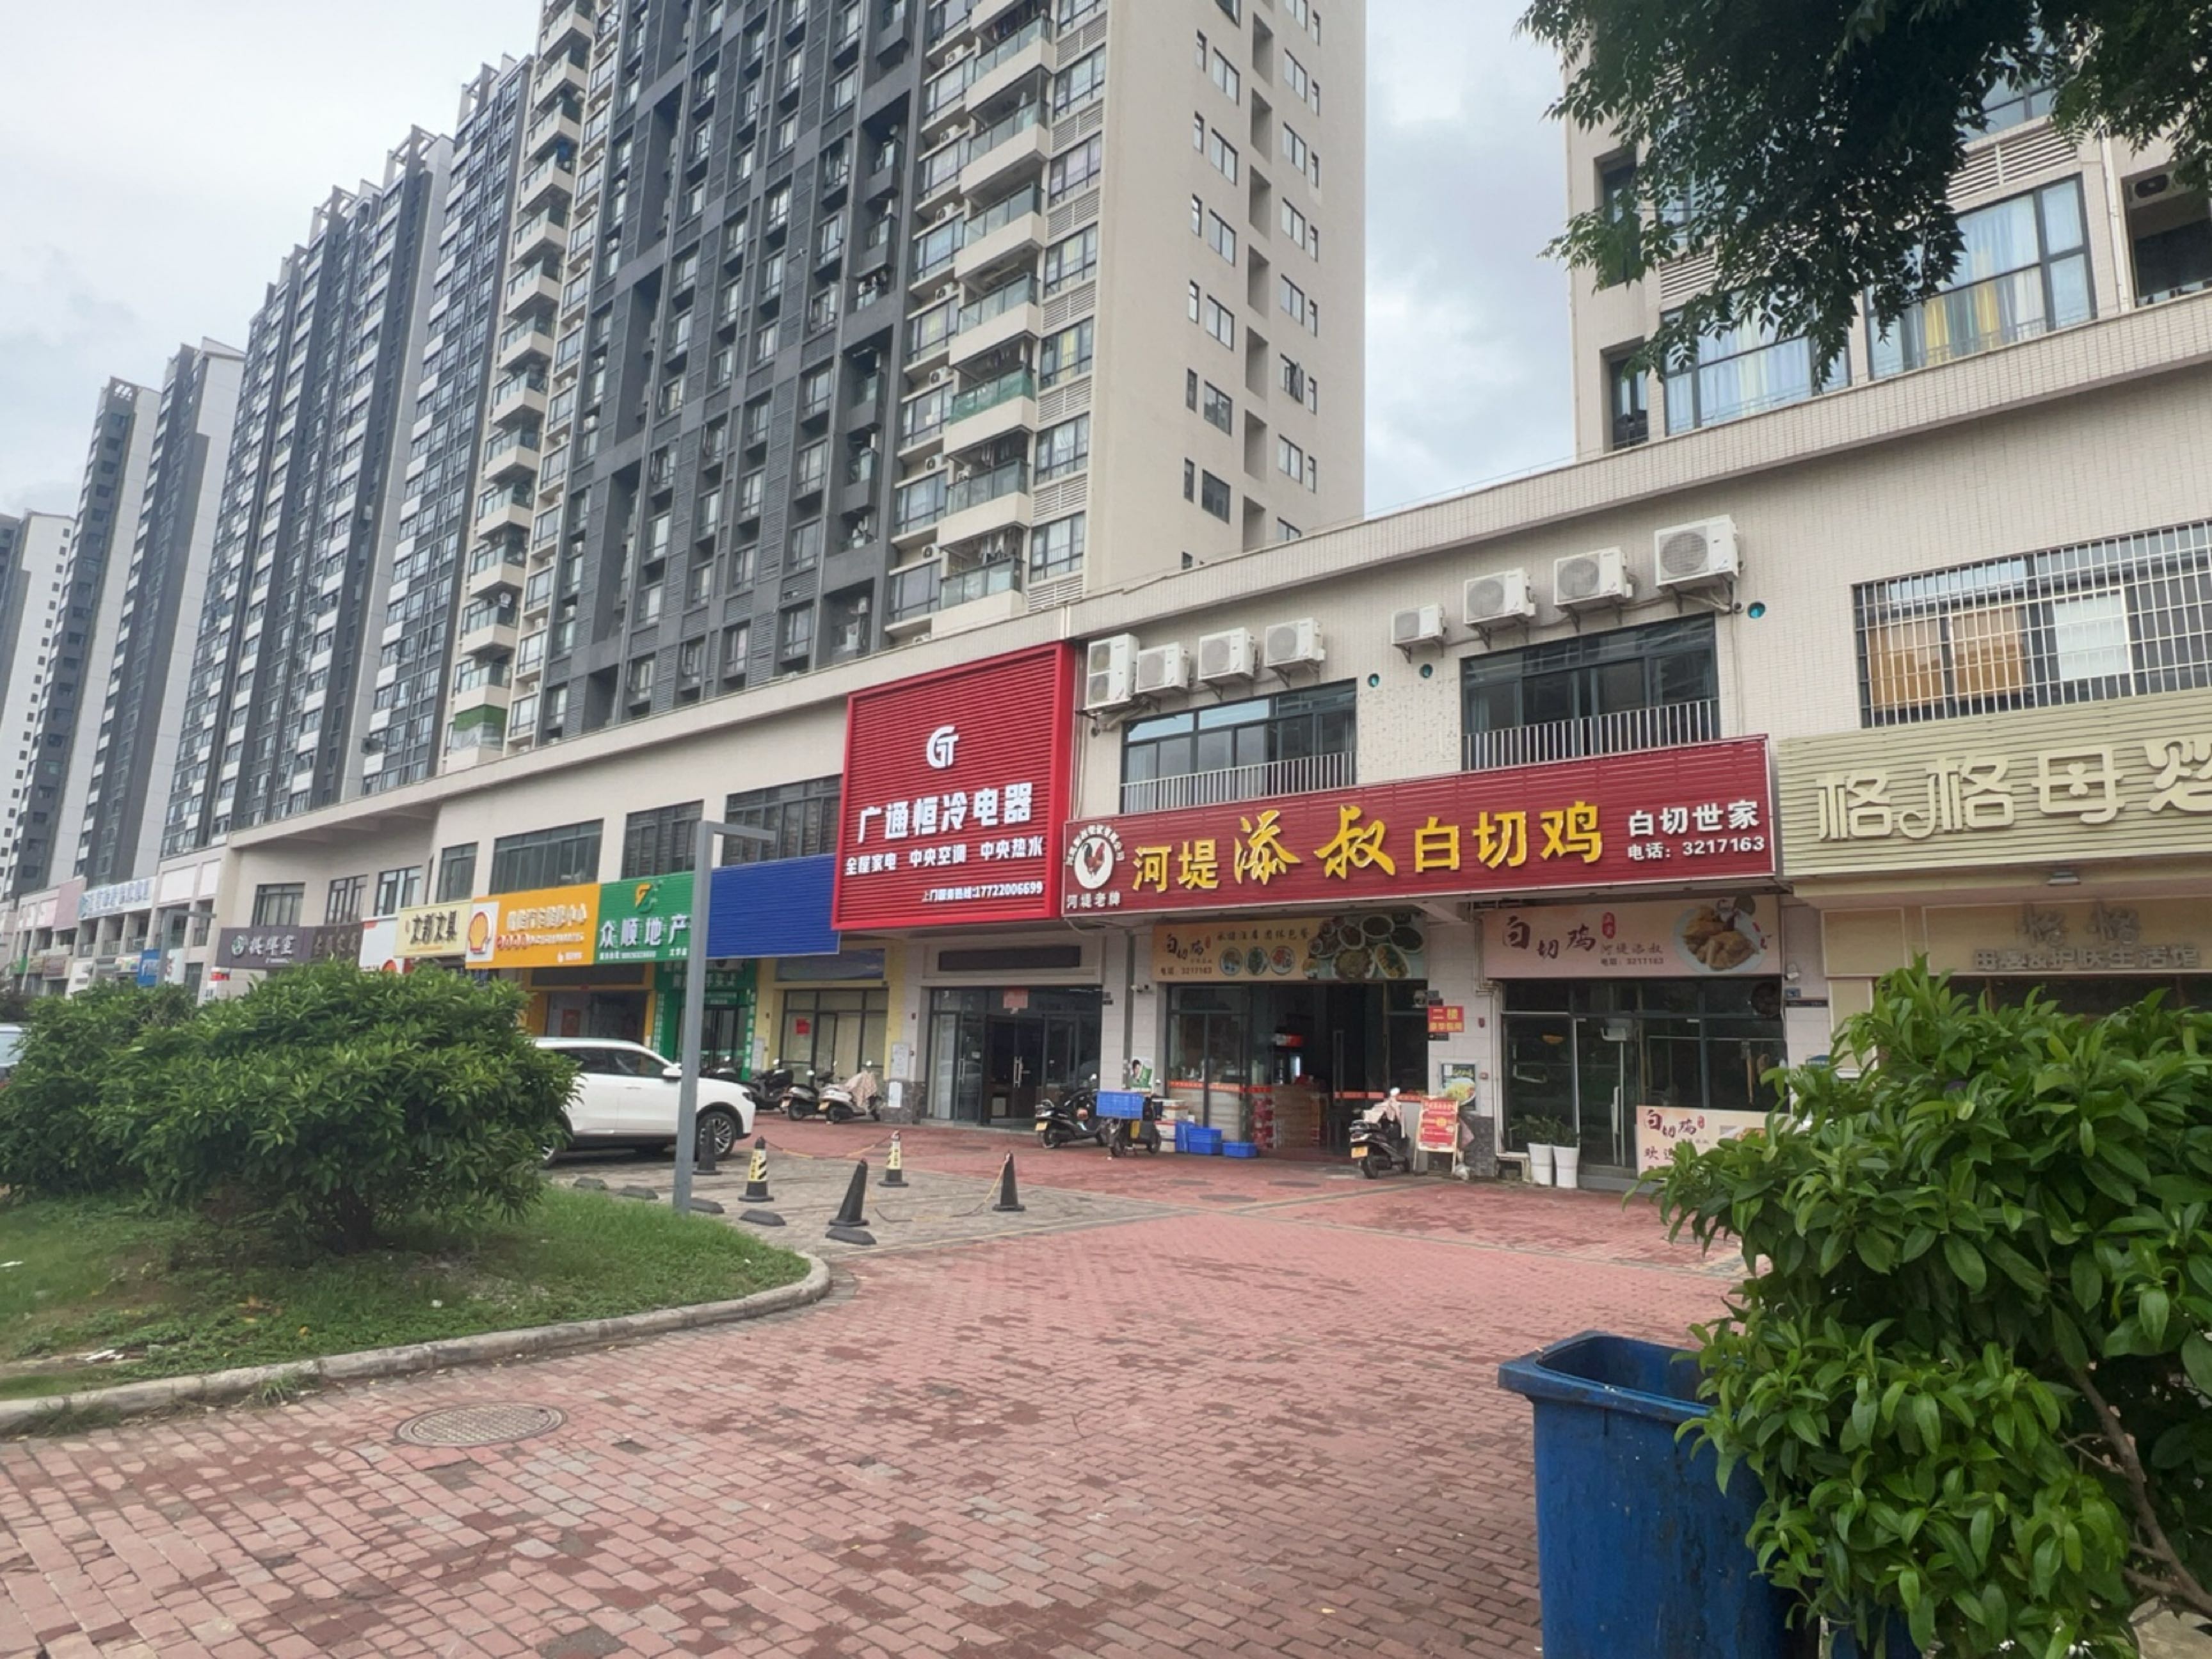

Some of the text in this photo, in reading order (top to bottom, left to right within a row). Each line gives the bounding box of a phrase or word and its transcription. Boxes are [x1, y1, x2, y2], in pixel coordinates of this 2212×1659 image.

[858, 782, 1033, 843] 广通恒冷电器
[1628, 799, 1760, 837] 白切世家
[909, 844, 967, 867] 中央空调
[980, 837, 1043, 860] 中央热水
[599, 914, 689, 948] 众顺地产
